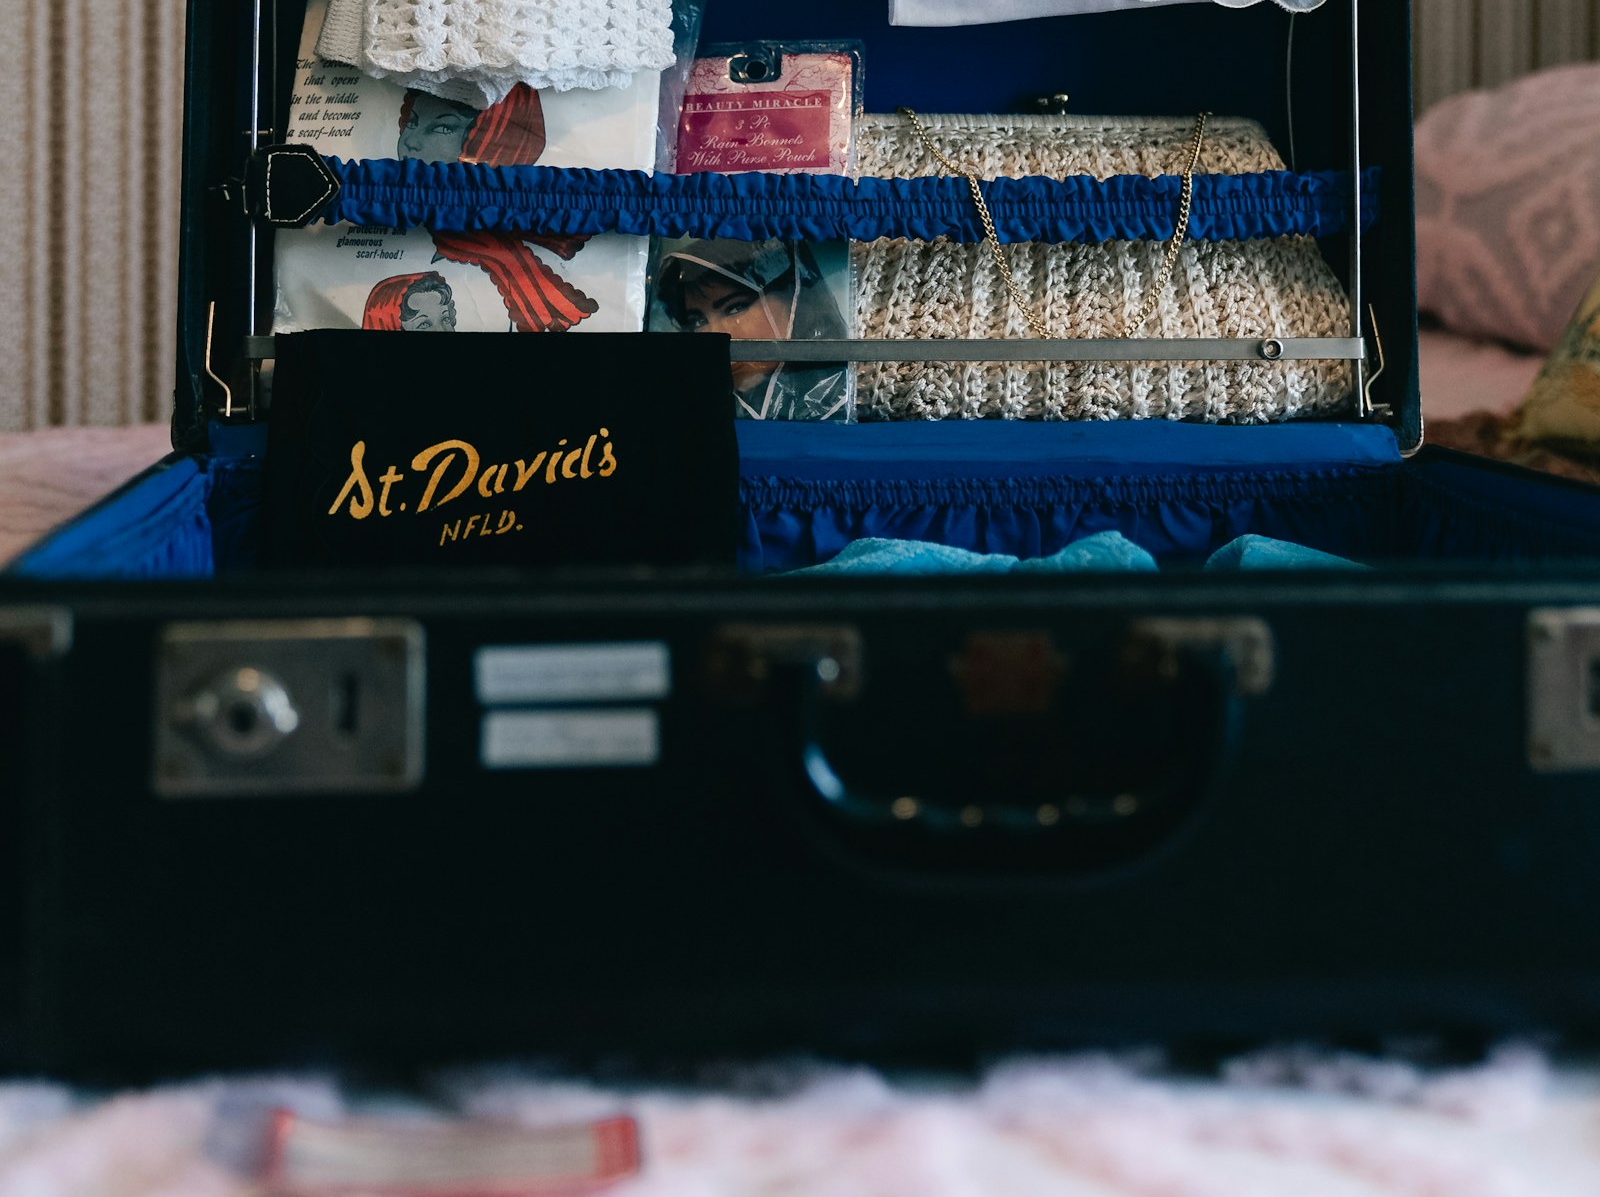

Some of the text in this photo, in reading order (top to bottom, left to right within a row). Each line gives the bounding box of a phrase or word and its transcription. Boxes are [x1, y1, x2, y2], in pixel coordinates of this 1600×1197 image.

[295, 59, 314, 70] The
[304, 74, 360, 88] that opens
[291, 93, 359, 105] in the middle
[686, 97, 822, 111] BEAUTY MIRACLE
[299, 109, 362, 121] and becomes
[735, 115, 770, 130] 3 Pc
[286, 126, 354, 140] a scarf-hood
[700, 133, 803, 150] Rain Bonnets
[688, 147, 816, 167] With Purse Pouch
[336, 236, 383, 248] glamourous
[327, 427, 618, 520] St. David's
[439, 509, 524, 547] NFLD.
